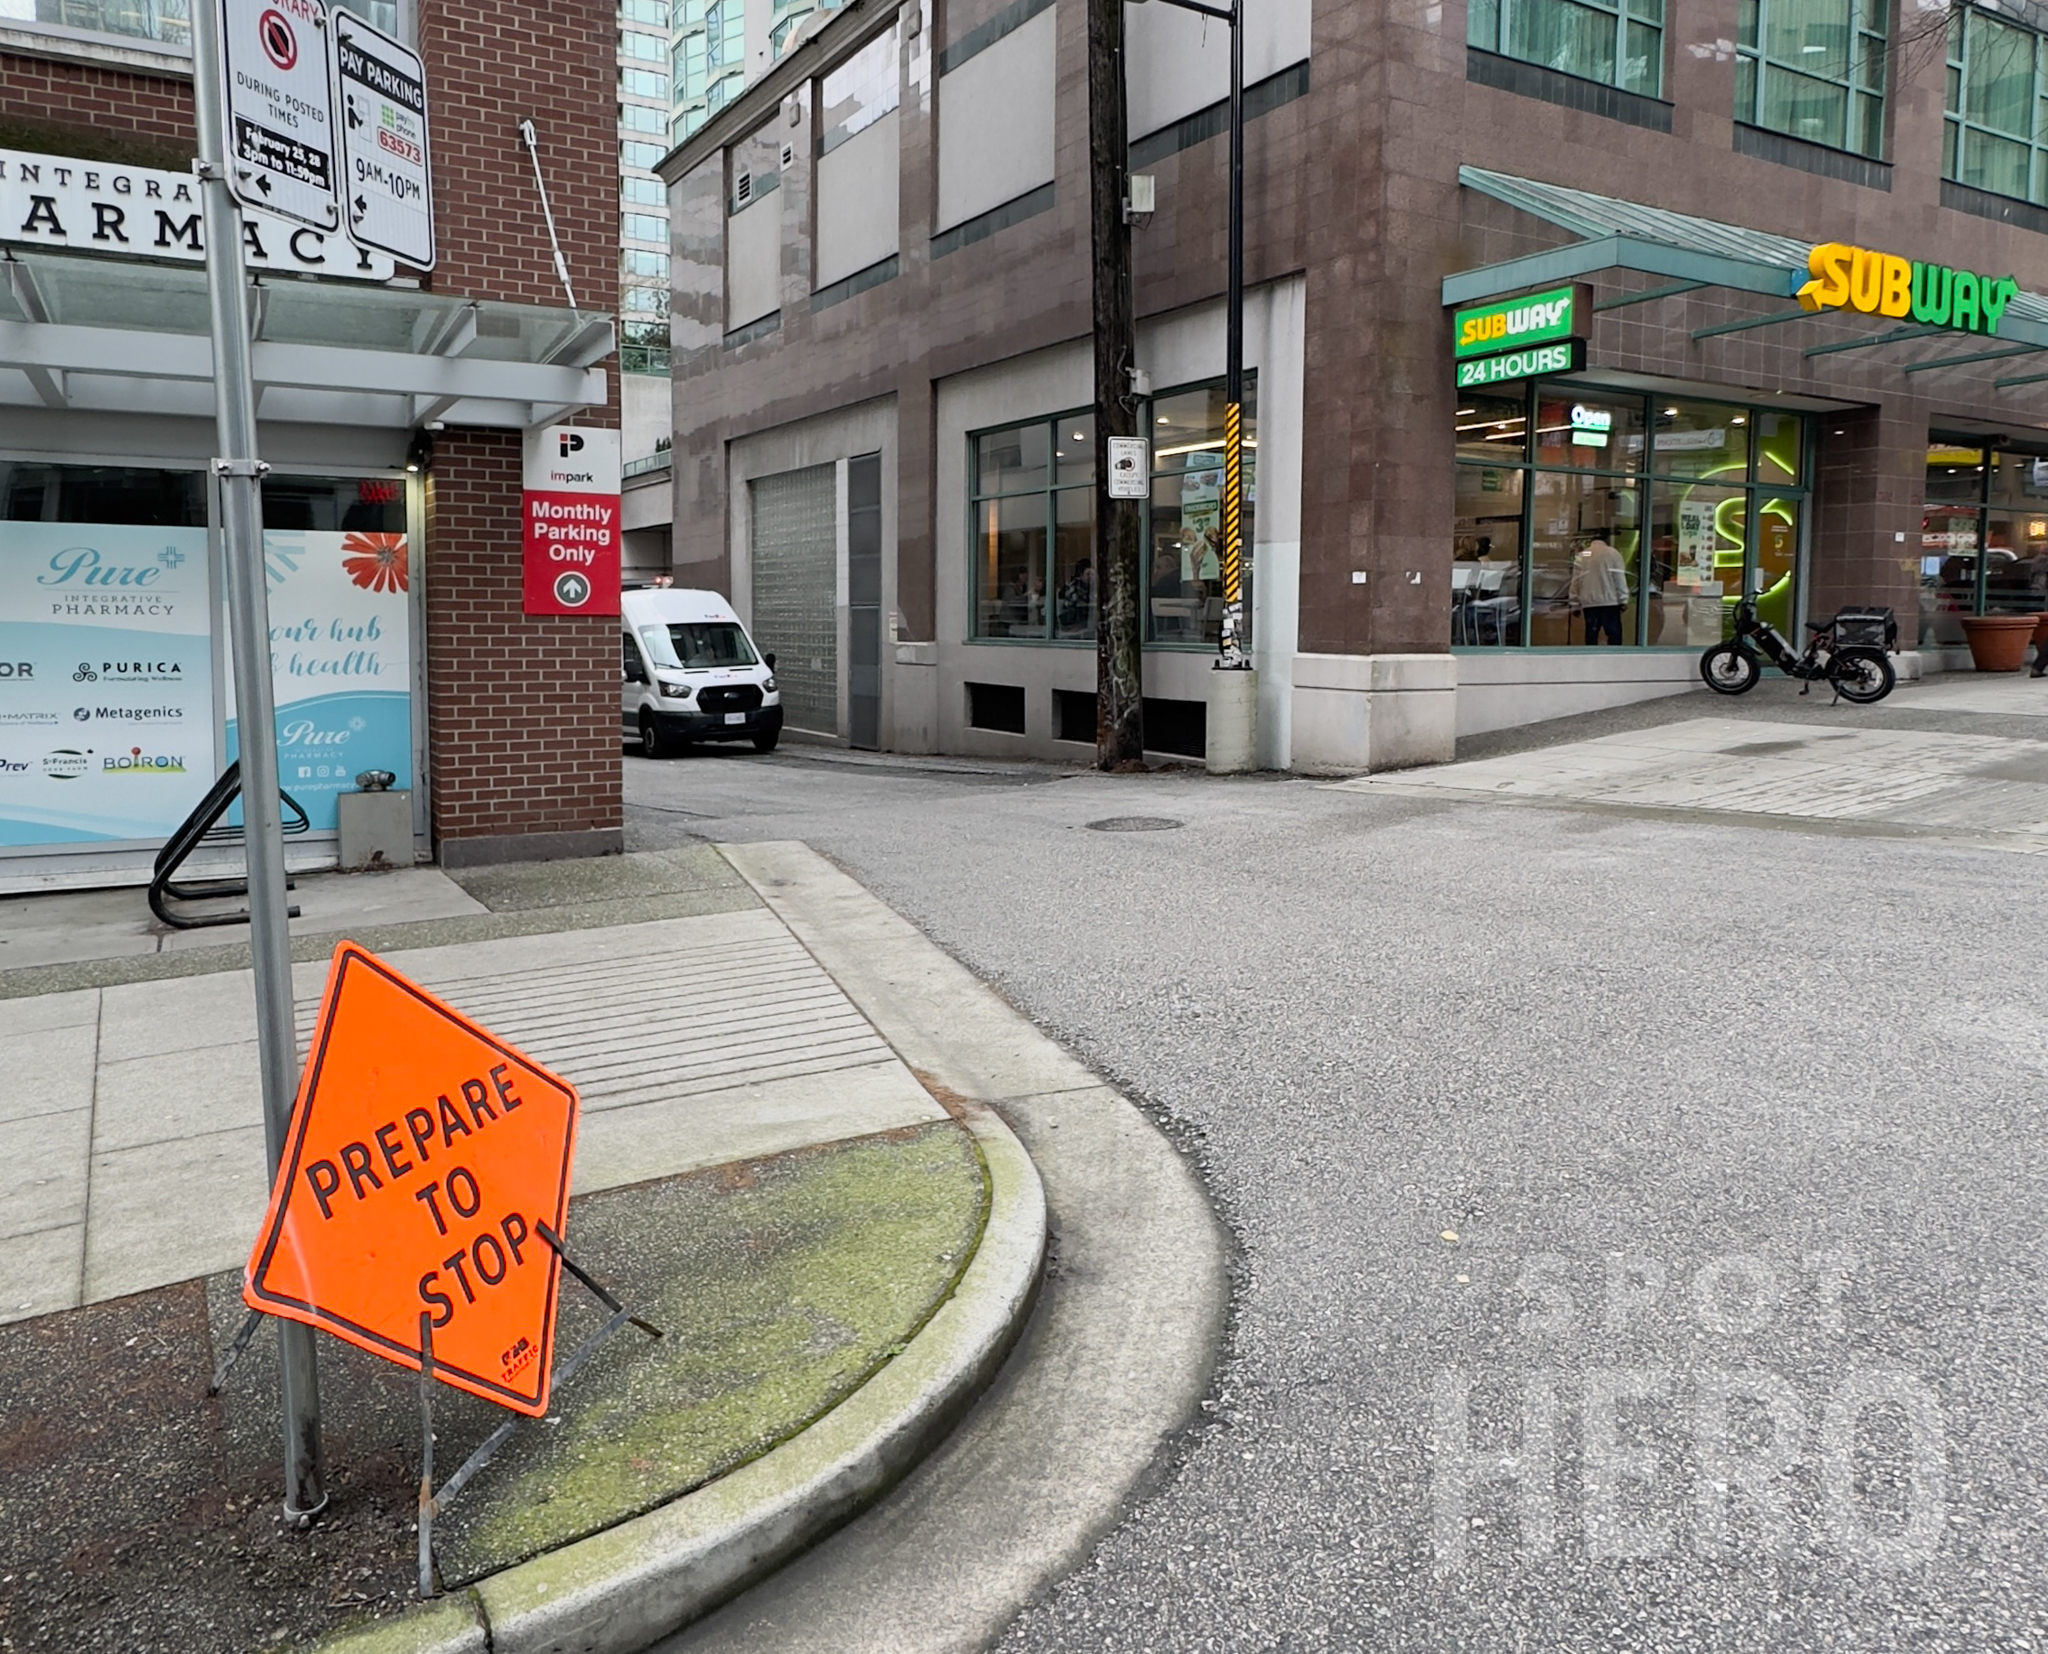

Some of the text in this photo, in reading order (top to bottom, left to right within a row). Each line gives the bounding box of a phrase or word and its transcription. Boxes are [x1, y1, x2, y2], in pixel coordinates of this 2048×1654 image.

[272, 0, 319, 22] RARY
[340, 46, 422, 109] PAY PARKING
[237, 71, 324, 123] DURING POSTED
[268, 103, 299, 128] TIMES
[242, 142, 269, 166] 3pm
[270, 155, 283, 170] to
[245, 126, 291, 158] February
[309, 153, 321, 168] 28
[379, 131, 421, 163] 63573
[356, 158, 421, 200] 9AM-10PM
[1797, 242, 2020, 336] SUBWAY
[1459, 297, 1571, 346] SUBWAY
[1461, 346, 1567, 385] 24 HOURS
[1571, 403, 1611, 427] Open
[550, 470, 594, 484] impark
[532, 501, 612, 526] Monthly
[534, 522, 611, 546] Parking
[37, 546, 161, 586] Pure
[548, 544, 596, 567] Only
[52, 603, 174, 616] PHARMACY
[64, 595, 162, 603] INTEGRATIVE
[330, 615, 387, 642] hub
[0, 662, 34, 678] OR
[103, 662, 182, 673] PURICA
[289, 651, 388, 677] health
[95, 705, 183, 721] Metagenics
[276, 719, 351, 747] Pure
[104, 748, 183, 769] BOIRON
[305, 1062, 523, 1220] PREPARE
[416, 1165, 481, 1236] TO
[418, 1211, 528, 1329] STOP
[501, 1344, 539, 1382] TRAFFIC
